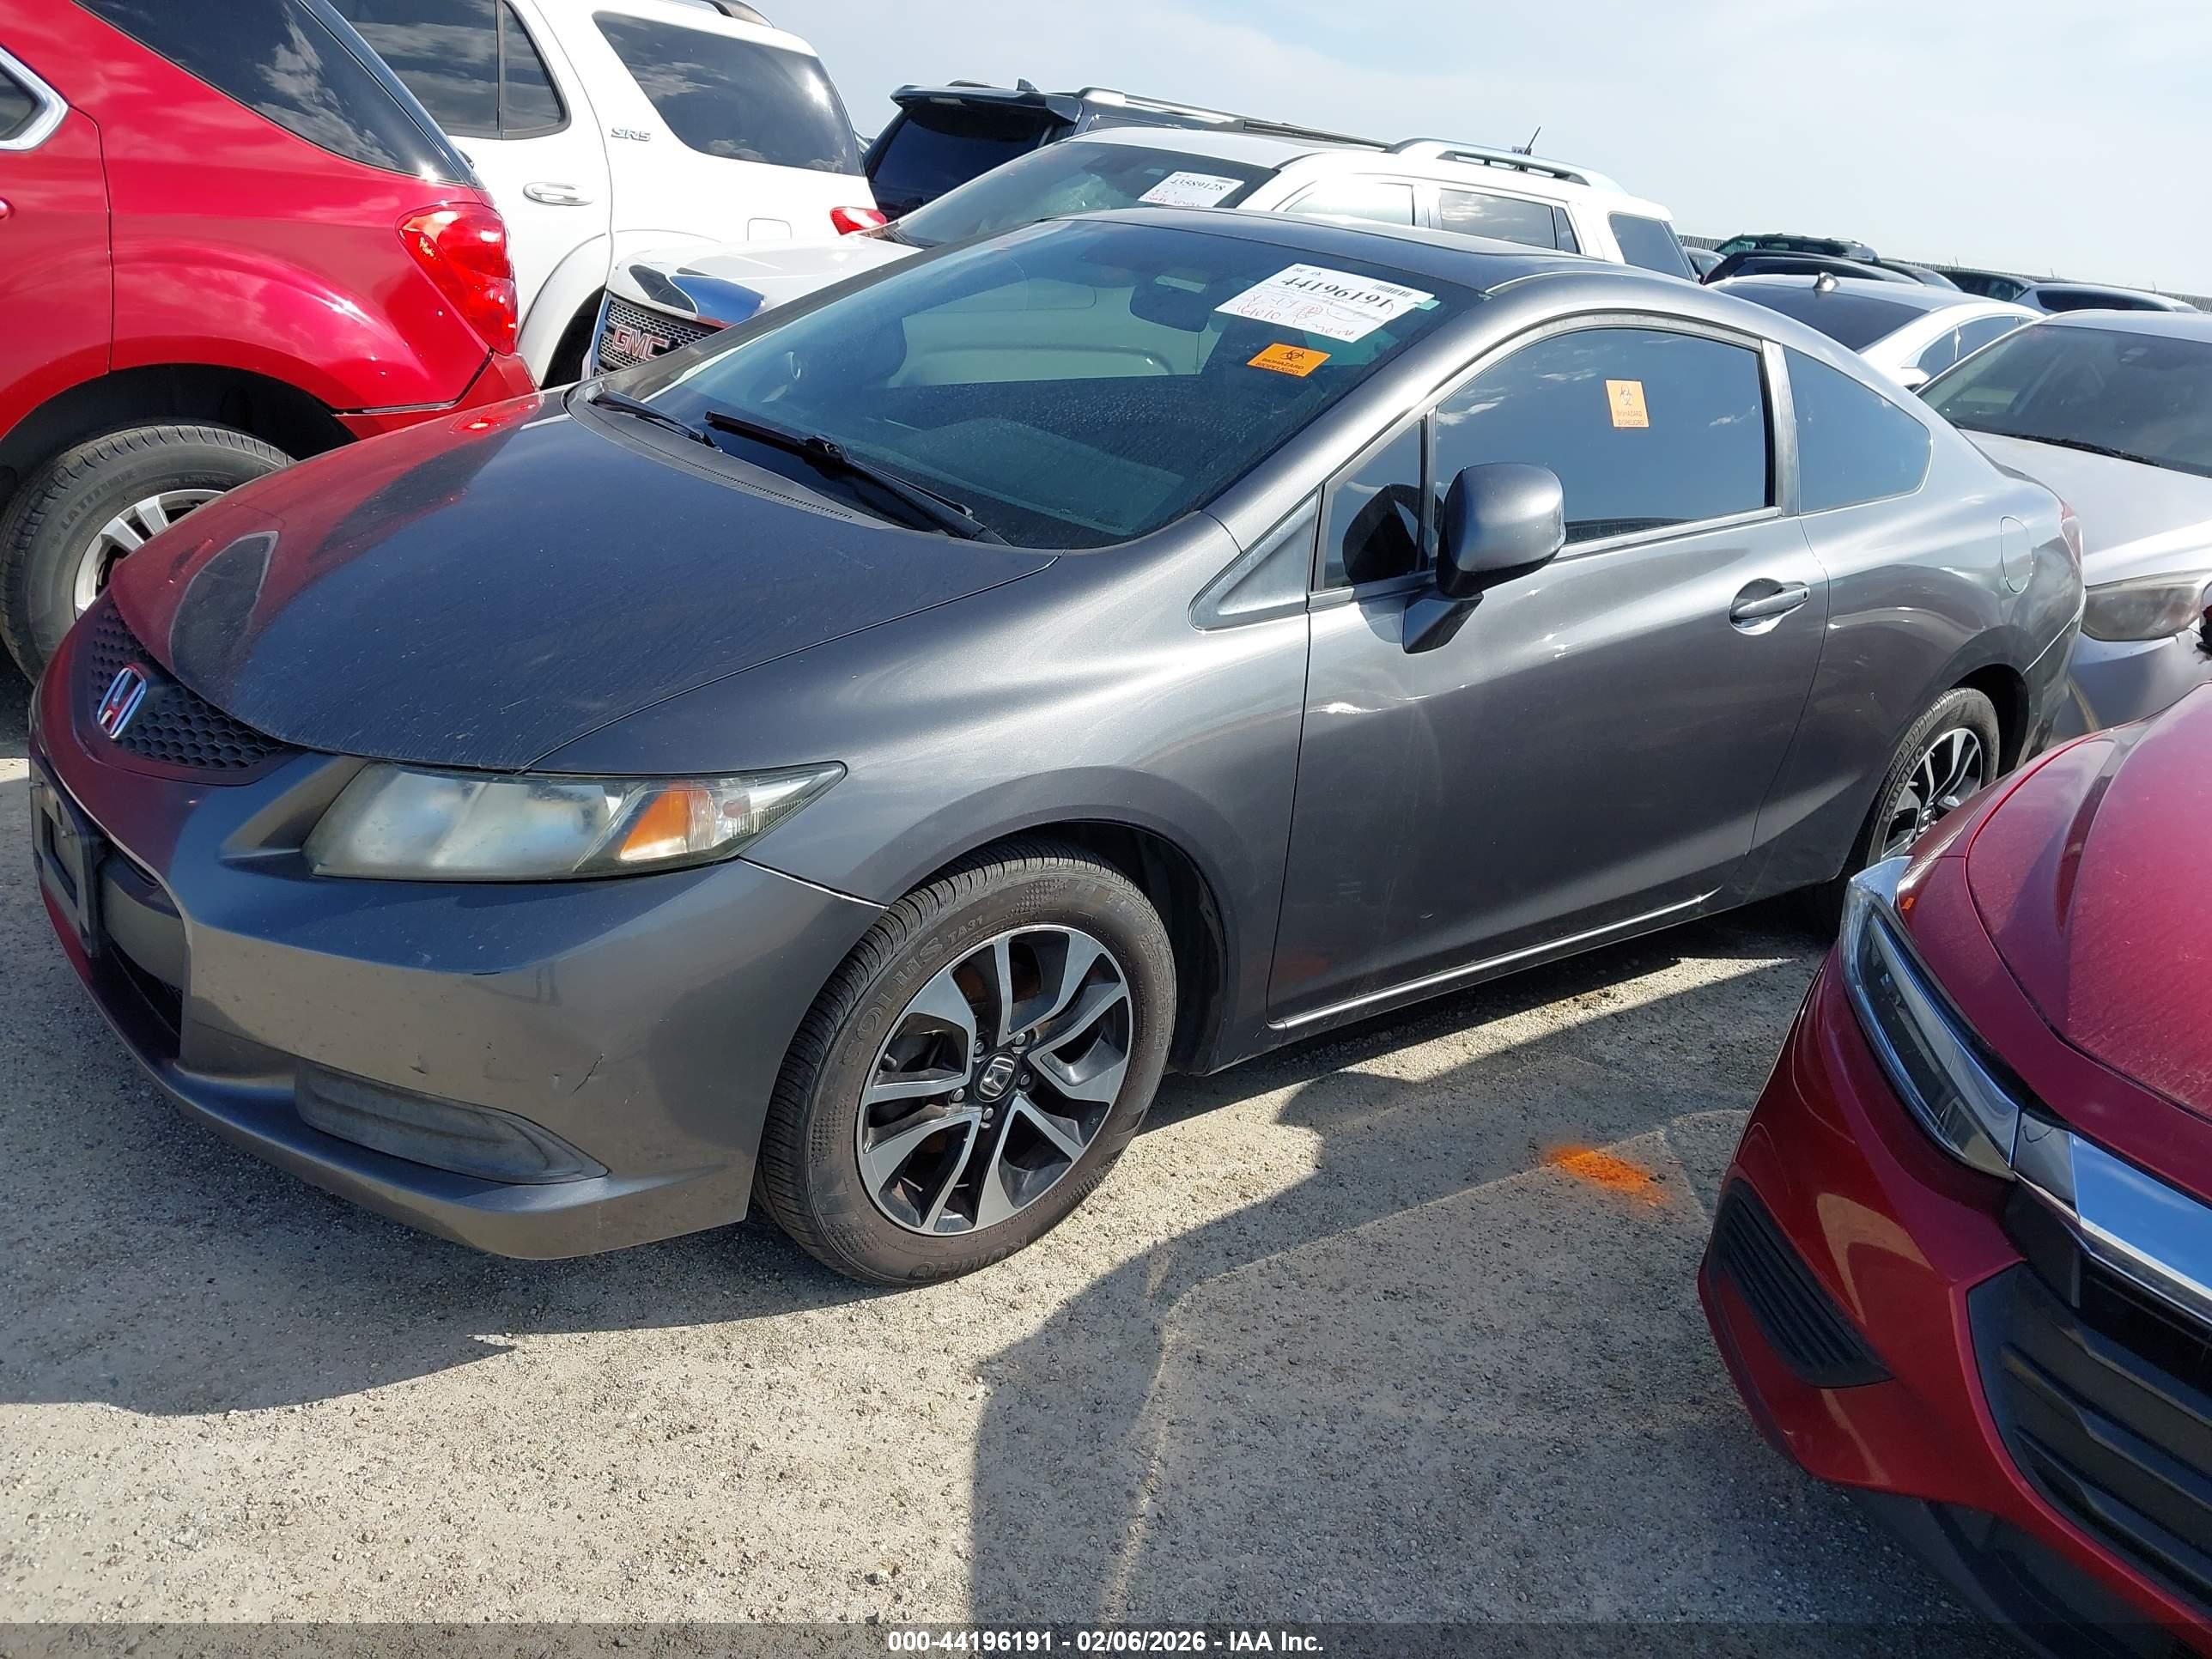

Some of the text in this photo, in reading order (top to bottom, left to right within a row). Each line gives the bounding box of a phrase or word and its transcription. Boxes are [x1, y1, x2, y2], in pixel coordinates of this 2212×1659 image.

[1280, 276, 1395, 307] 44196191
[612, 325, 671, 361] GMC
[1882, 745, 1925, 823] KUMHO
